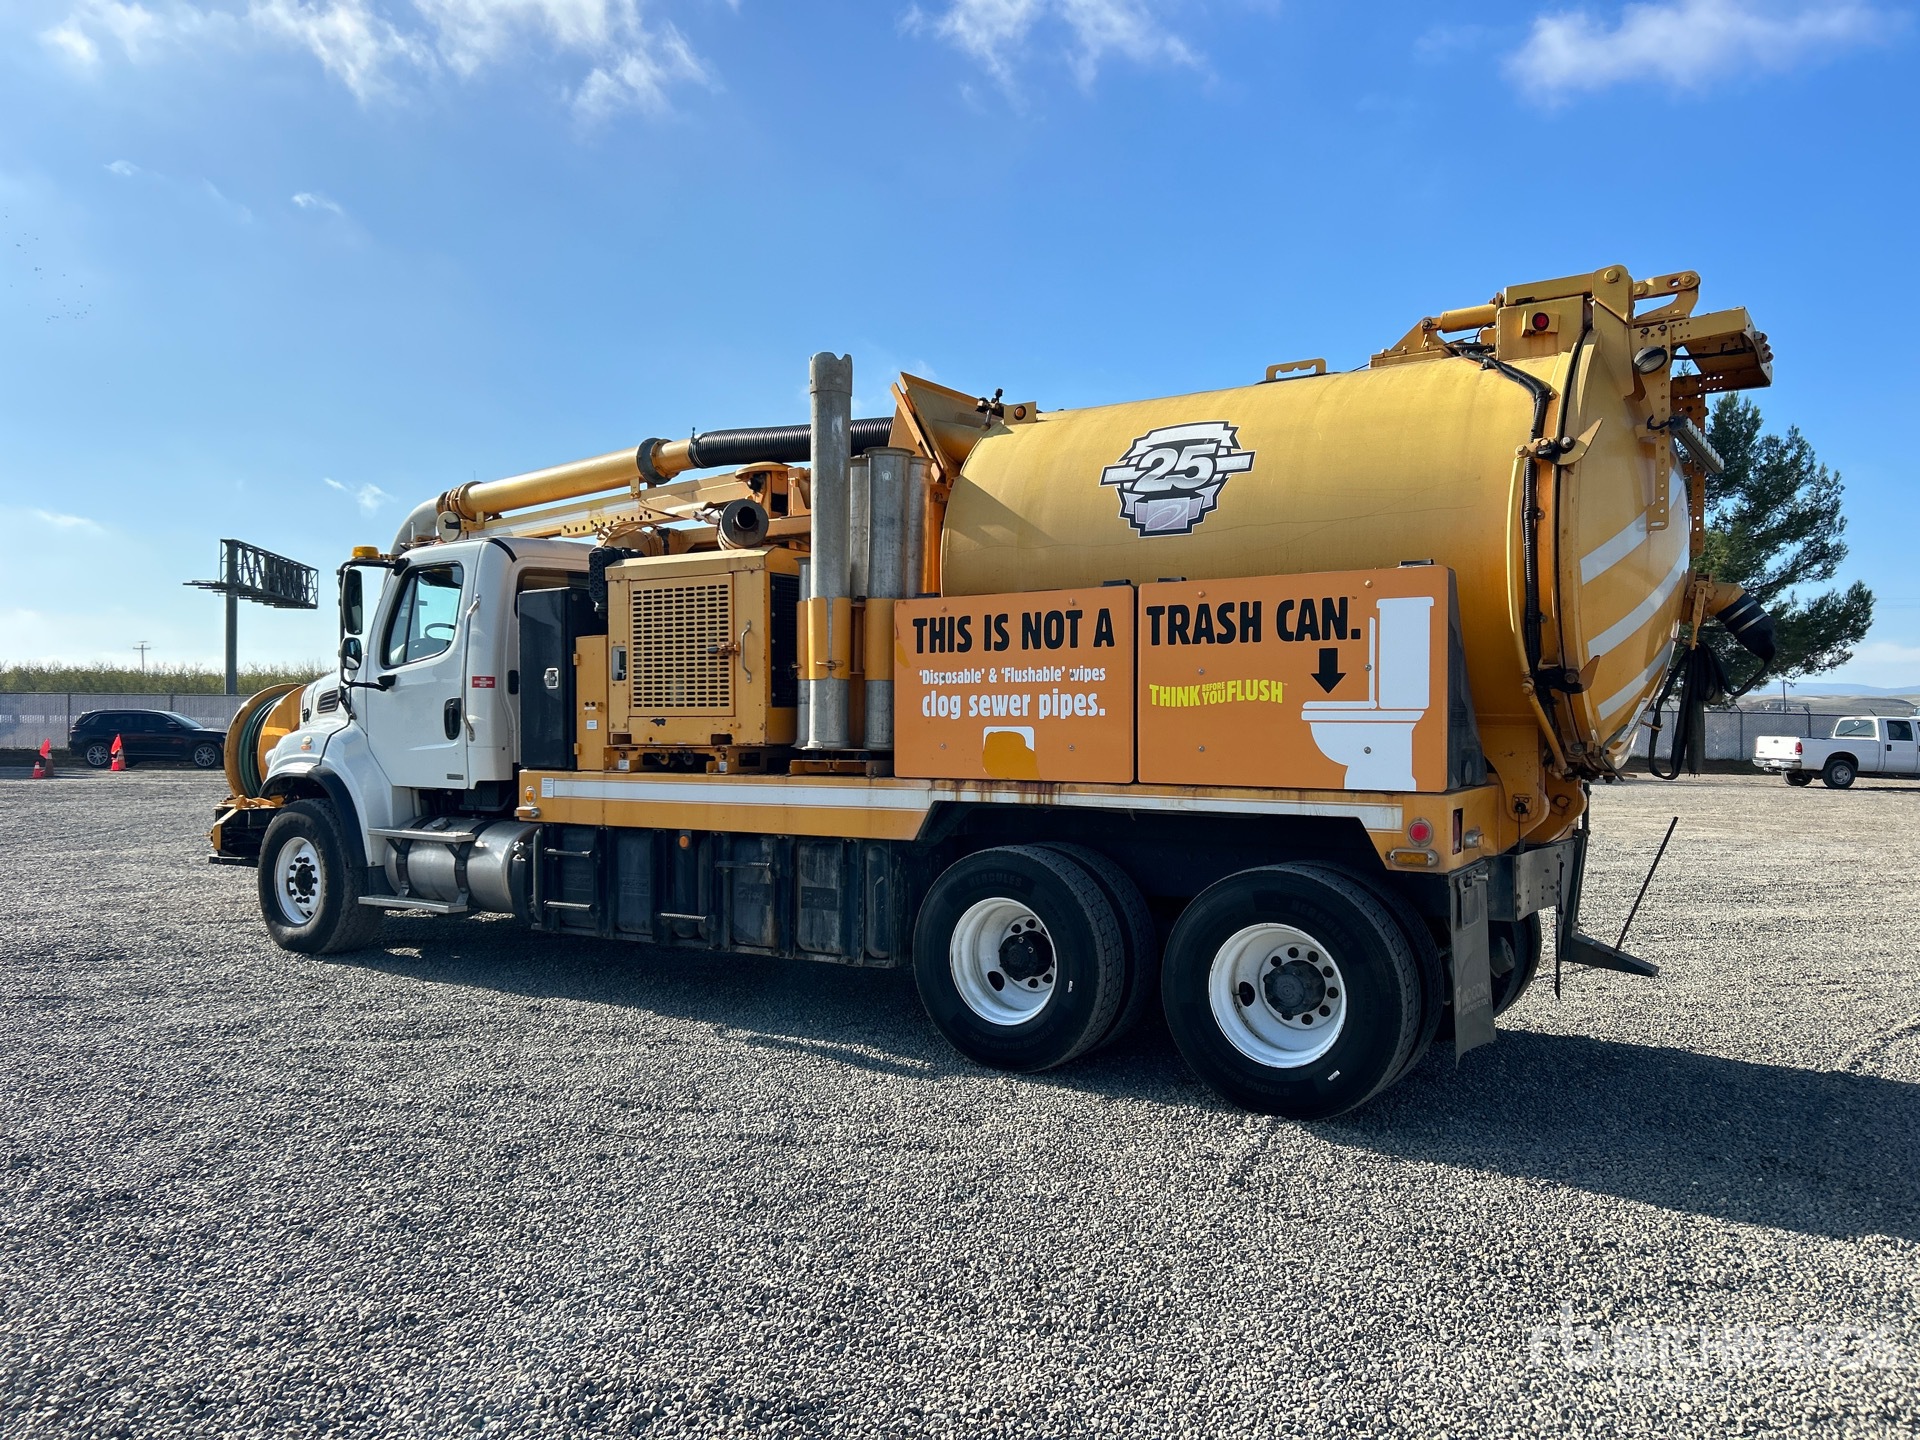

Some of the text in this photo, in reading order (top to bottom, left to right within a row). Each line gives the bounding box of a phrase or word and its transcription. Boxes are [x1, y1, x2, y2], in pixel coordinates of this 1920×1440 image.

[1133, 442, 1218, 492] 25
[912, 607, 1115, 654] THIS IS NOT A
[1146, 596, 1361, 646] TRASH CAN.
[988, 667, 998, 684] &
[1069, 665, 1106, 684] wipes
[922, 688, 1106, 720] clog sewer pipes.
[1149, 679, 1283, 708] THINK BEFORE YOU FLUSH
[967, 871, 1023, 888] HERCULES
